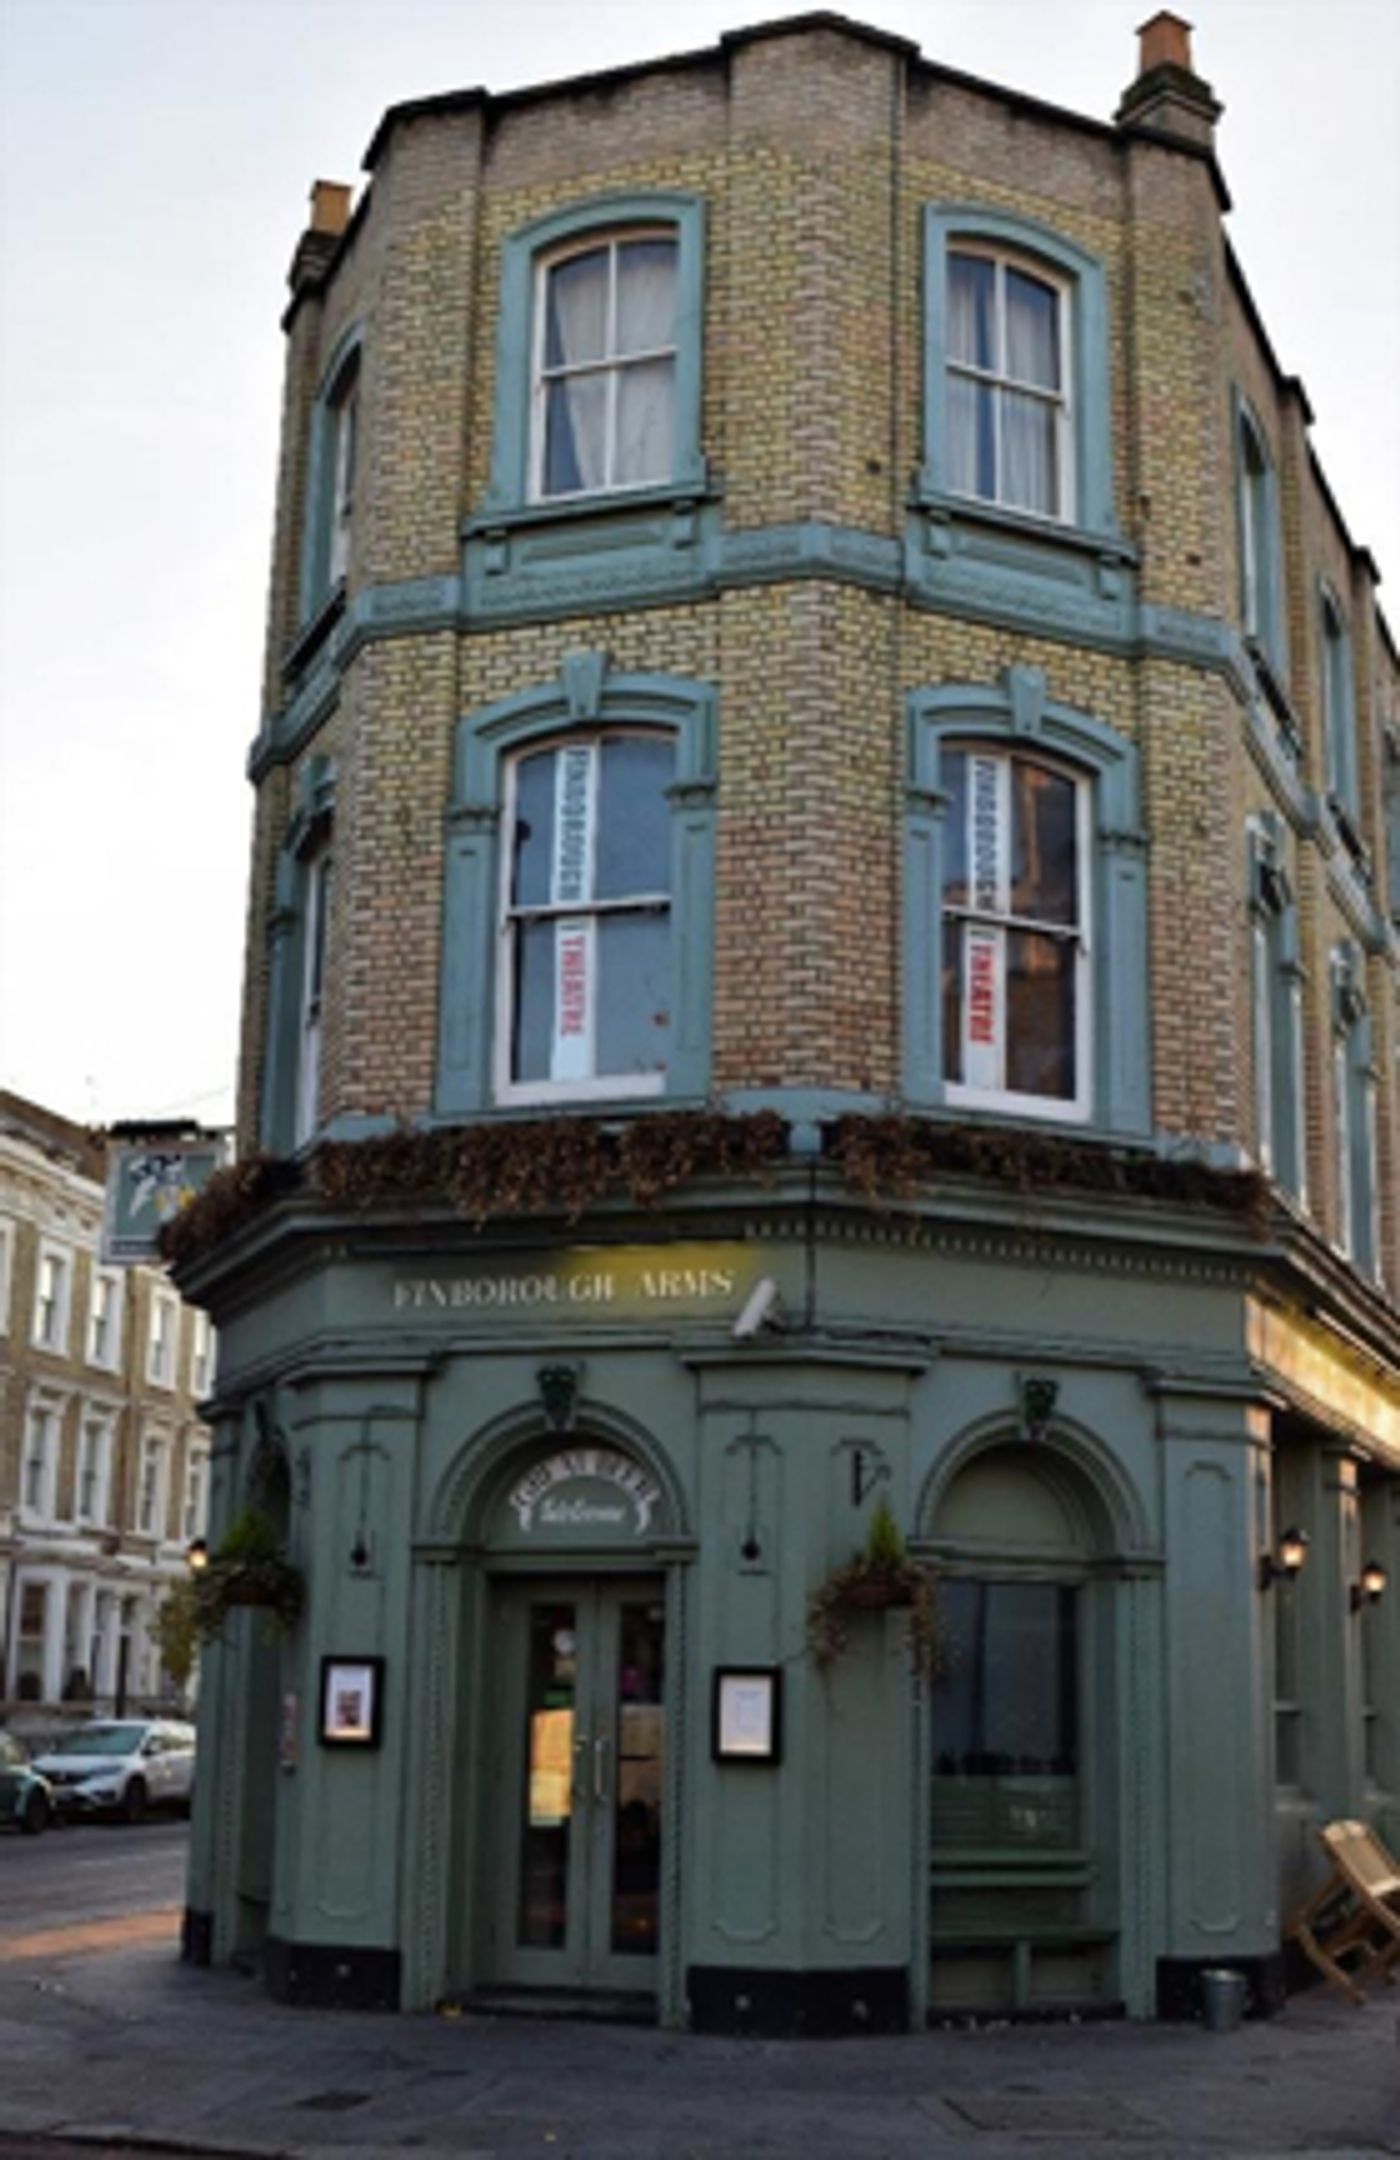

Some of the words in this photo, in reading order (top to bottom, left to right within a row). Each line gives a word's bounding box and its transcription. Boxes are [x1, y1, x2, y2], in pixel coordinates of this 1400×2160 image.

[560, 934, 586, 1037] THEATRE
[968, 943, 995, 1045] THEATRE
[393, 1272, 615, 1308] FINBOROUGH
[638, 1267, 735, 1299] ARMS
